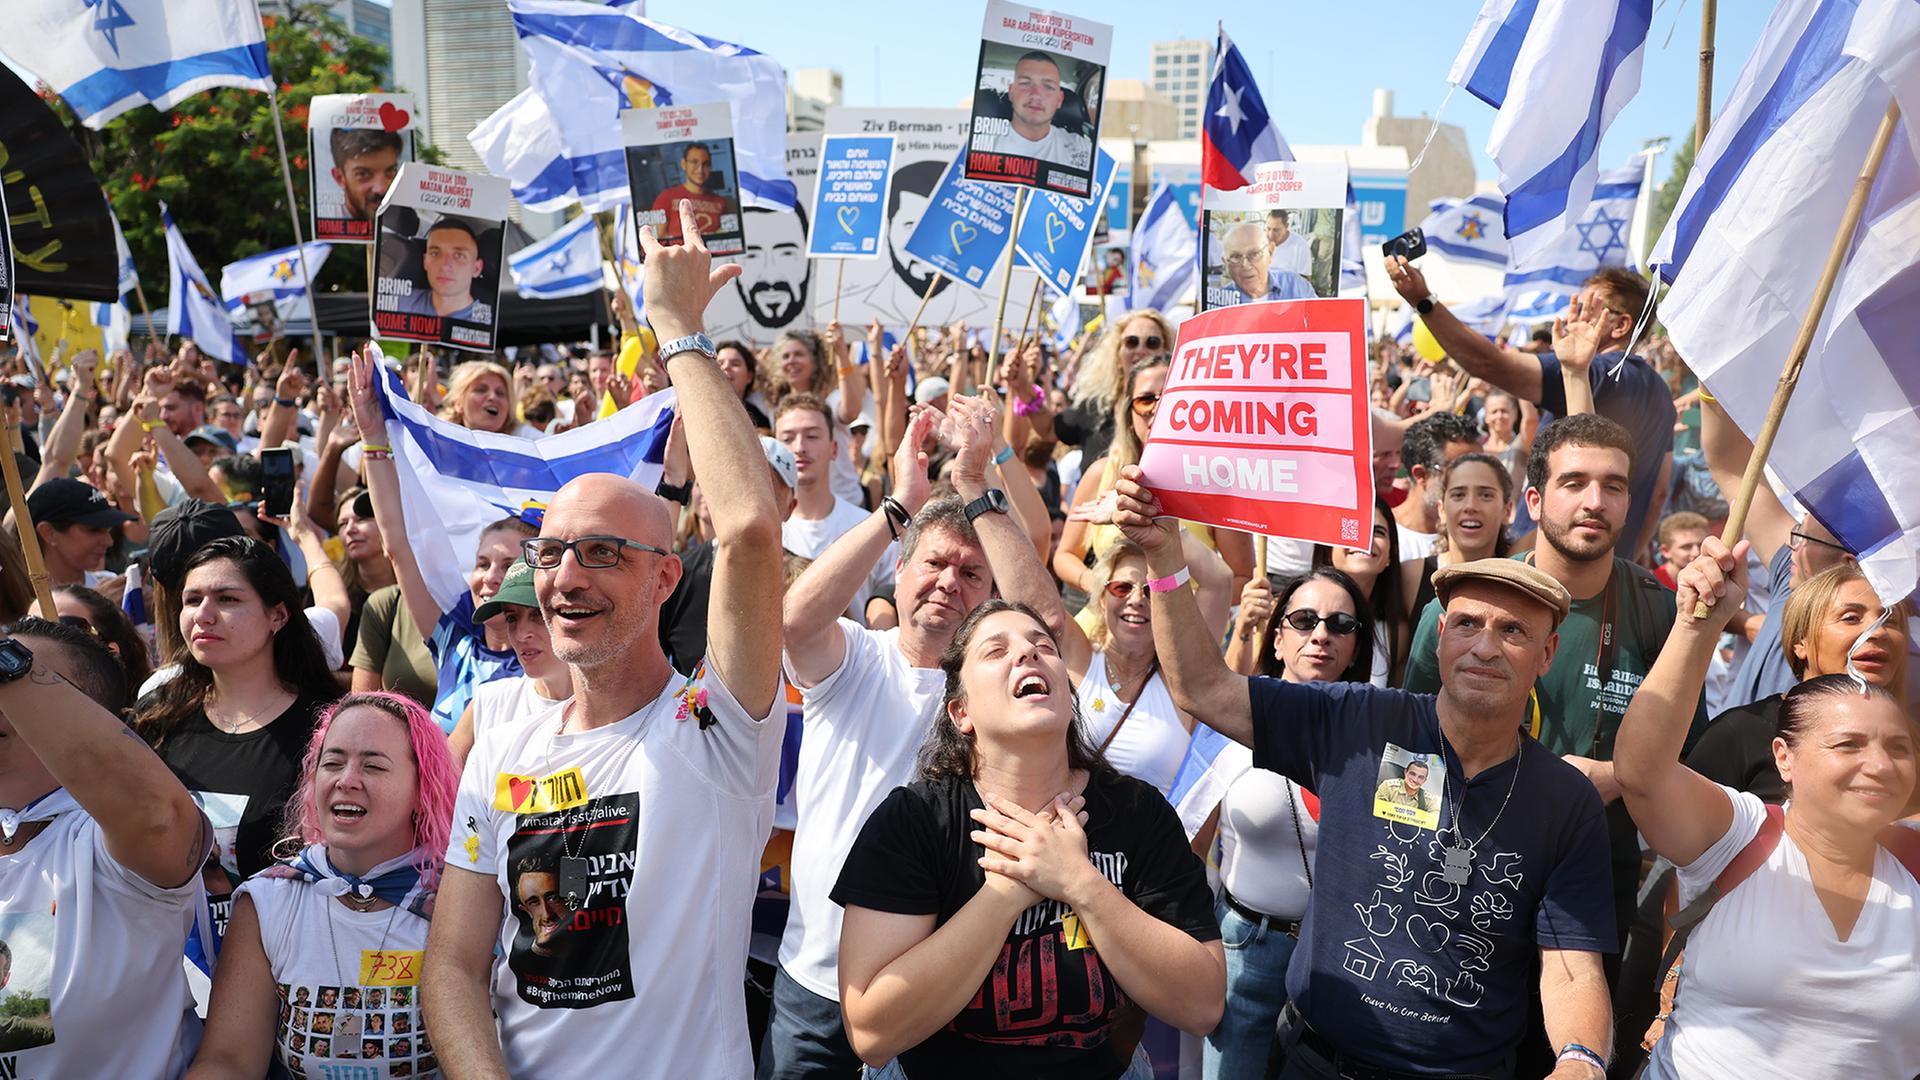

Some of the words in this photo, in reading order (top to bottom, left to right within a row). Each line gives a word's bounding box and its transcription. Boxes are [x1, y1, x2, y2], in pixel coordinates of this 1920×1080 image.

[1002, 18, 1016, 29] BAR
[1018, 21, 1050, 34] ABRAHAM
[1052, 27, 1094, 45] KUPERSHTEIN
[863, 120, 884, 132] Ziv
[888, 120, 942, 132] Berman
[974, 116, 1009, 136] BRING
[971, 134, 995, 152] HIM
[786, 148, 816, 162] ברמן
[969, 152, 1002, 173] HOME
[1004, 156, 1039, 178] NOW!
[419, 180, 442, 193] MATAN
[443, 185, 473, 197] ANGREST
[1275, 181, 1303, 192] COOPER
[941, 197, 970, 218] בבית
[955, 191, 1003, 220] מאושרים
[318, 219, 344, 234] HOME
[637, 208, 667, 226] BRING
[968, 210, 1005, 235] שאתם
[378, 277, 412, 296] BRING
[1206, 286, 1240, 306] BRING
[376, 294, 399, 312] HIM
[375, 312, 407, 331] HOME
[409, 316, 441, 335] NOW!
[1180, 343, 1328, 381] THEY'RE
[1169, 399, 1318, 437] COMING
[1182, 454, 1298, 493] HOME
[1603, 623, 1612, 646] EOS
[1590, 700, 1627, 714] PARADIS
[598, 804, 630, 819] alive.
[588, 850, 635, 877] אבינ
[370, 951, 414, 980] 738
[1385, 1002, 1399, 1014] No
[1400, 1007, 1419, 1018] One
